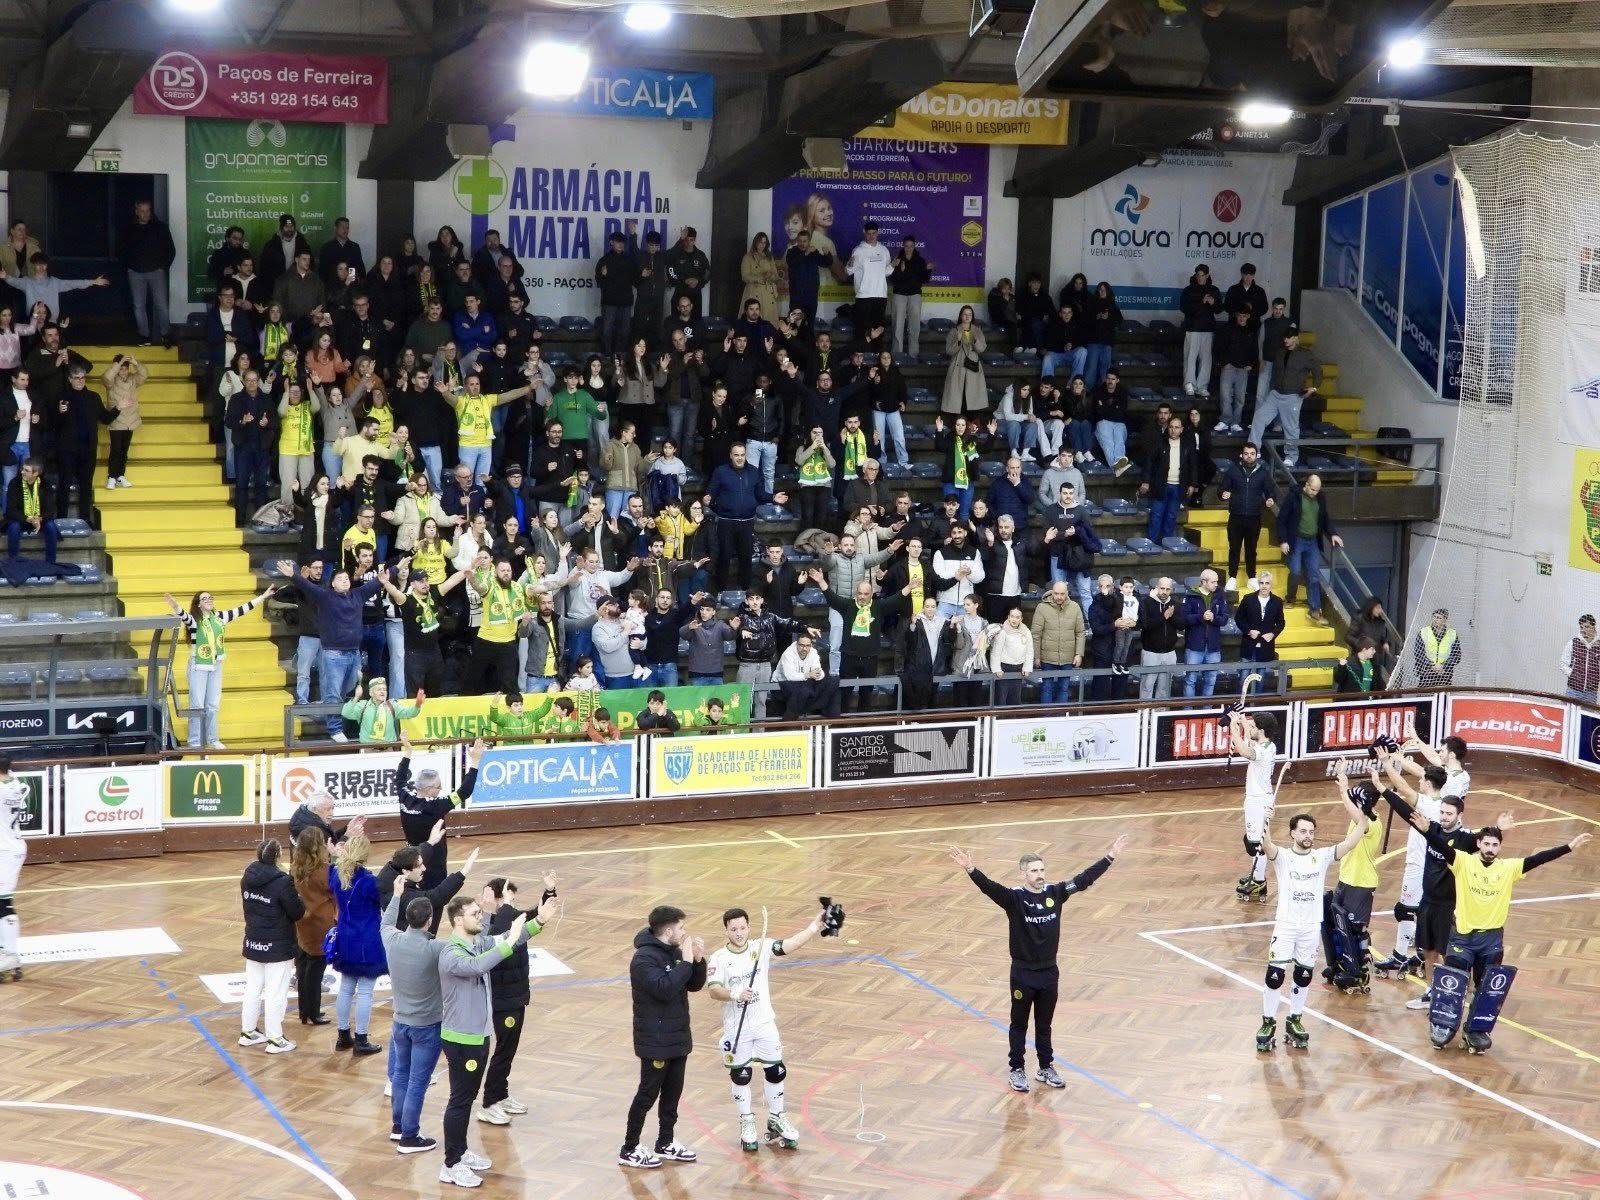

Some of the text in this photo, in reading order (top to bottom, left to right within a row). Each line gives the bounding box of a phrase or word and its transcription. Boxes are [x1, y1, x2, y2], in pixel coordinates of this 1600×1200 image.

[156, 65, 196, 87] DS
[217, 64, 374, 87] Paços de Ferreira
[230, 91, 359, 109] +351 928 154 643
[931, 120, 1031, 135] APOIA O DESPORTO
[204, 151, 328, 169] grupomartins
[845, 153, 910, 163] AÇOS DE FERREIRA
[852, 170, 886, 181] PASSO
[887, 171, 916, 182] PARA
[916, 171, 925, 182] O
[926, 172, 972, 184] FUTURO!
[815, 181, 852, 190] Formamos
[862, 183, 894, 191] criadores
[904, 184, 926, 192] futuro
[926, 184, 948, 194] digital
[205, 191, 289, 205] Combustíveis
[655, 197, 670, 214] DA
[869, 202, 909, 210] TECNOLOGIA
[868, 214, 916, 223] PROGRAMAÇÃO
[508, 215, 591, 260] MATA
[876, 227, 900, 235] BÓTICA
[1091, 228, 1171, 248] moura
[1186, 230, 1265, 249] moura
[1090, 248, 1143, 259] VENTILAÇÕES
[1185, 249, 1237, 260] CORTE LASER
[553, 277, 593, 291] PAÇOS
[1323, 709, 1416, 744] PLACARD
[1454, 718, 1562, 738] publinor
[839, 735, 884, 748] SANTOS
[697, 750, 746, 764] ACADEMIA
[748, 749, 760, 760] DE
[839, 746, 889, 759] MOREIRA
[665, 755, 691, 780] ASK
[697, 758, 803, 776] DE PAÇOS DE FERREIRA
[324, 768, 412, 788] RIBEIR
[193, 797, 221, 806] Ferrara
[197, 803, 218, 812] Plaza
[84, 807, 144, 823] Castrol
